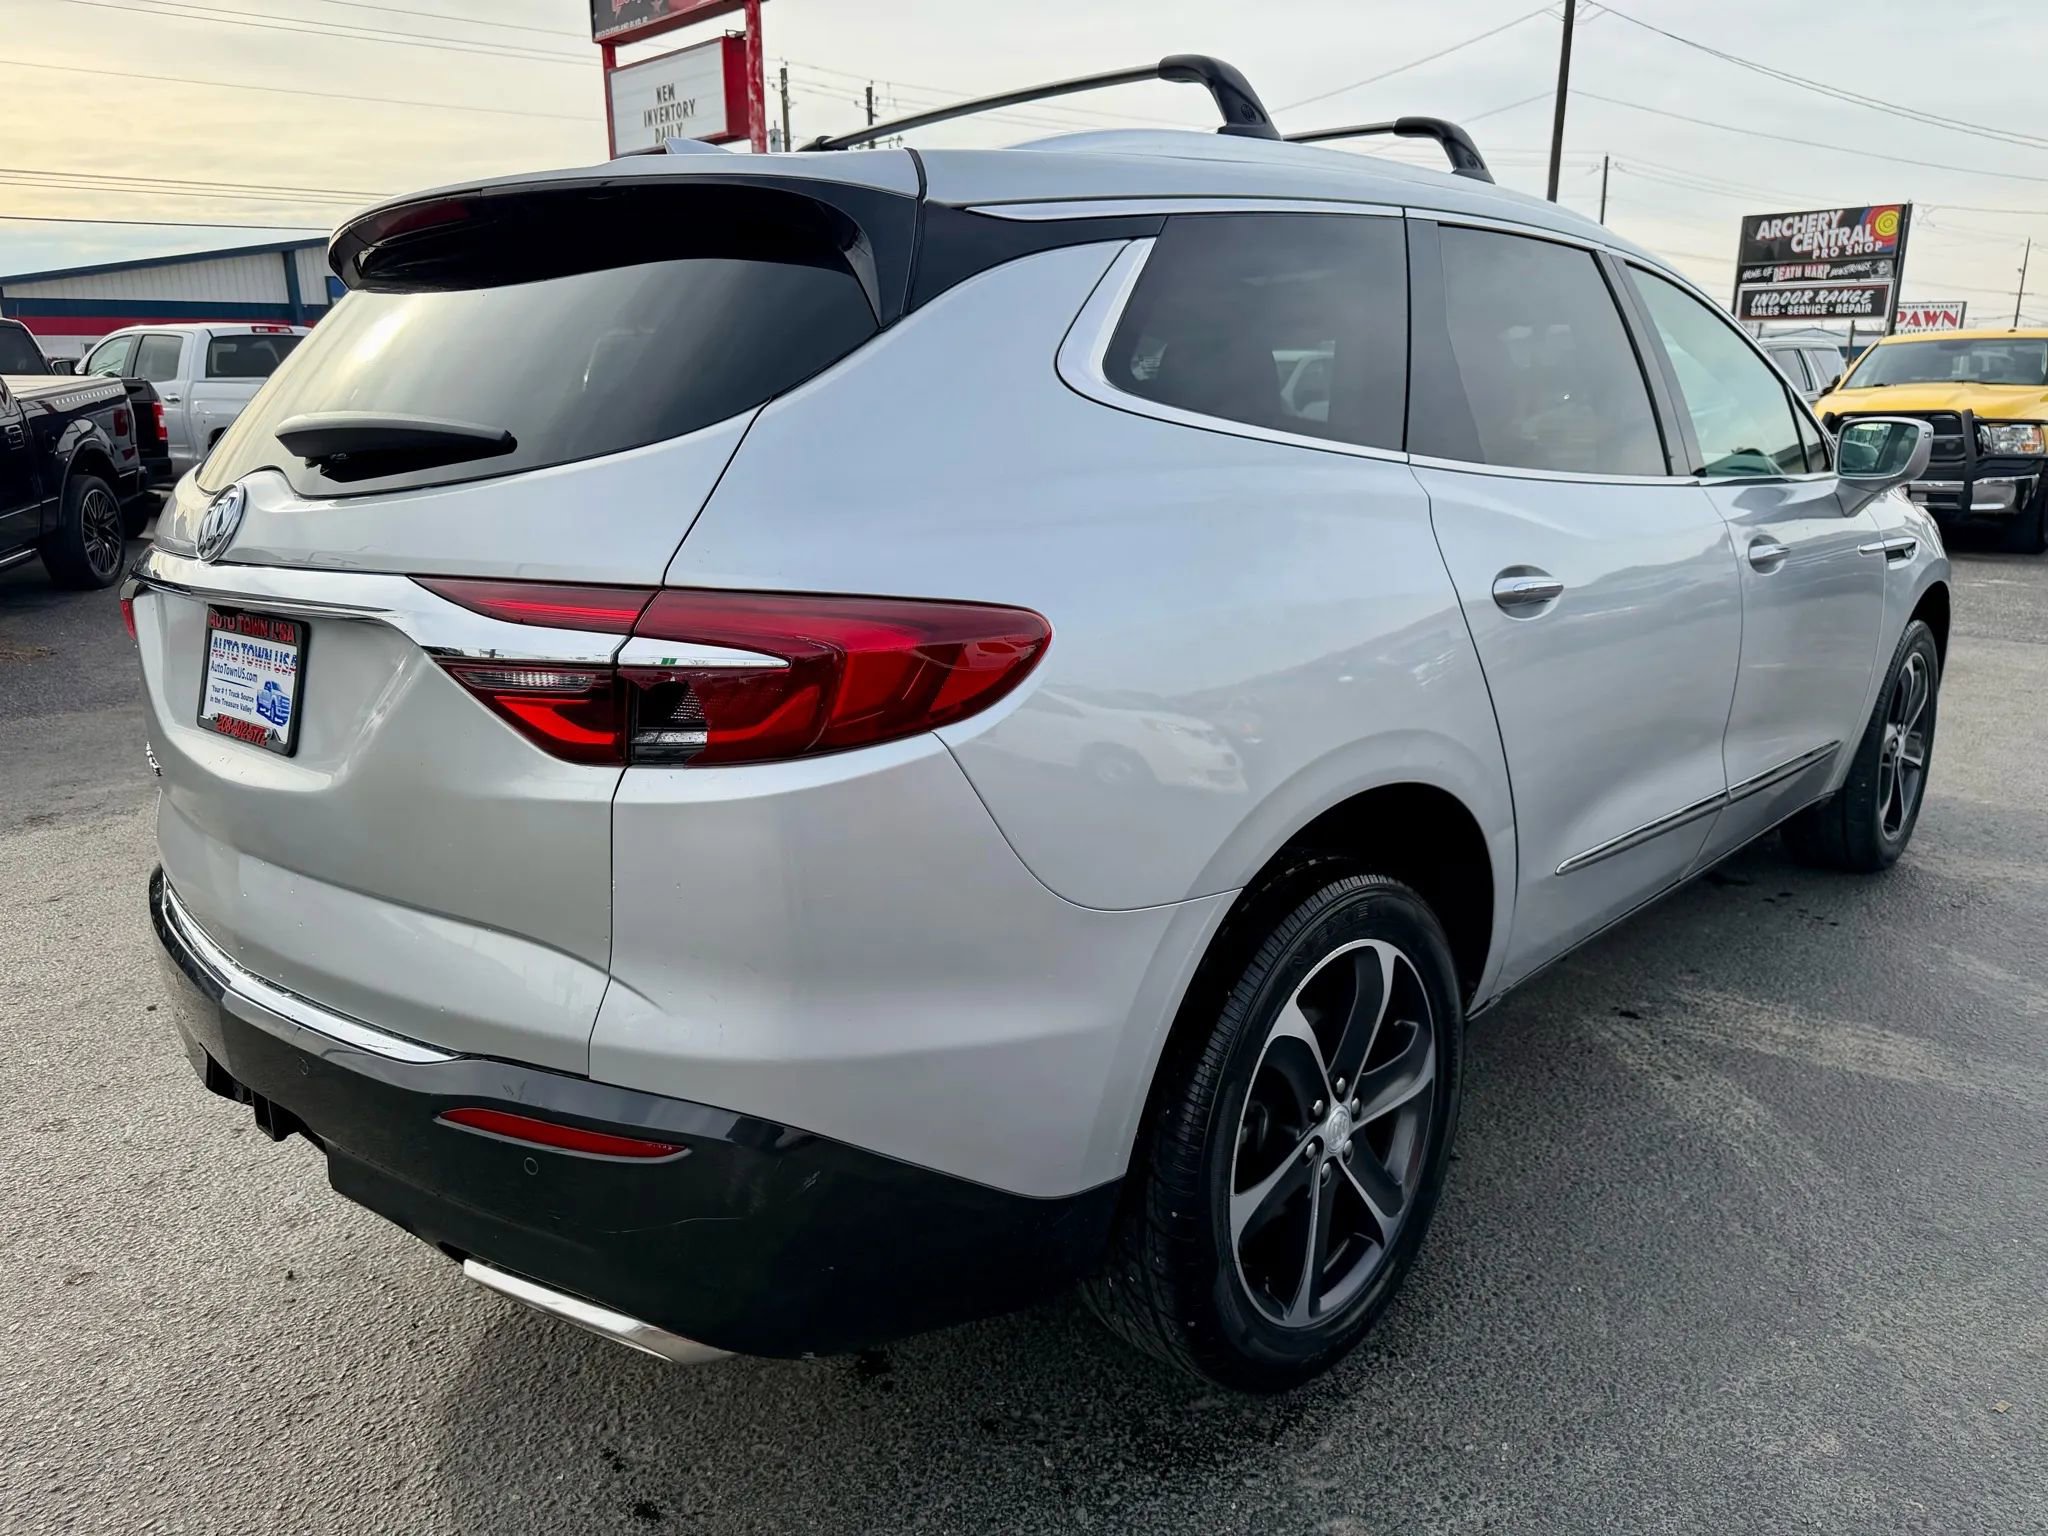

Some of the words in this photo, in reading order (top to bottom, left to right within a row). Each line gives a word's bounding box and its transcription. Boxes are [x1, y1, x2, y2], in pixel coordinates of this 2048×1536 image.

[643, 98, 696, 128] INVENTORY
[655, 121, 683, 144] DAILY
[1756, 210, 1844, 240] ARCHERY
[1791, 224, 1874, 253] CENTRAL
[1812, 248, 1839, 259] PRO
[1845, 241, 1883, 256] SHOP
[1742, 268, 1762, 280] HOME
[1763, 266, 1774, 277] OF
[1773, 264, 1803, 282] DEATH
[1751, 290, 1814, 306] INDOOR
[1815, 289, 1875, 304] RANGE
[1750, 304, 1780, 316] SALES
[1787, 304, 1827, 315] SERVICE
[1835, 303, 1872, 313] REPAIR
[1896, 309, 1959, 328] PAWN
[208, 612, 237, 631] AUTO
[239, 615, 270, 638] TOWN
[271, 621, 296, 643] USA
[211, 636, 240, 662] AUTO
[241, 642, 273, 671] TOWN
[274, 650, 297, 677] USA
[210, 660, 258, 682] AutoTownUS.com
[221, 698, 240, 709] Treasure
[228, 689, 240, 698] Truck
[240, 692, 255, 703] Source
